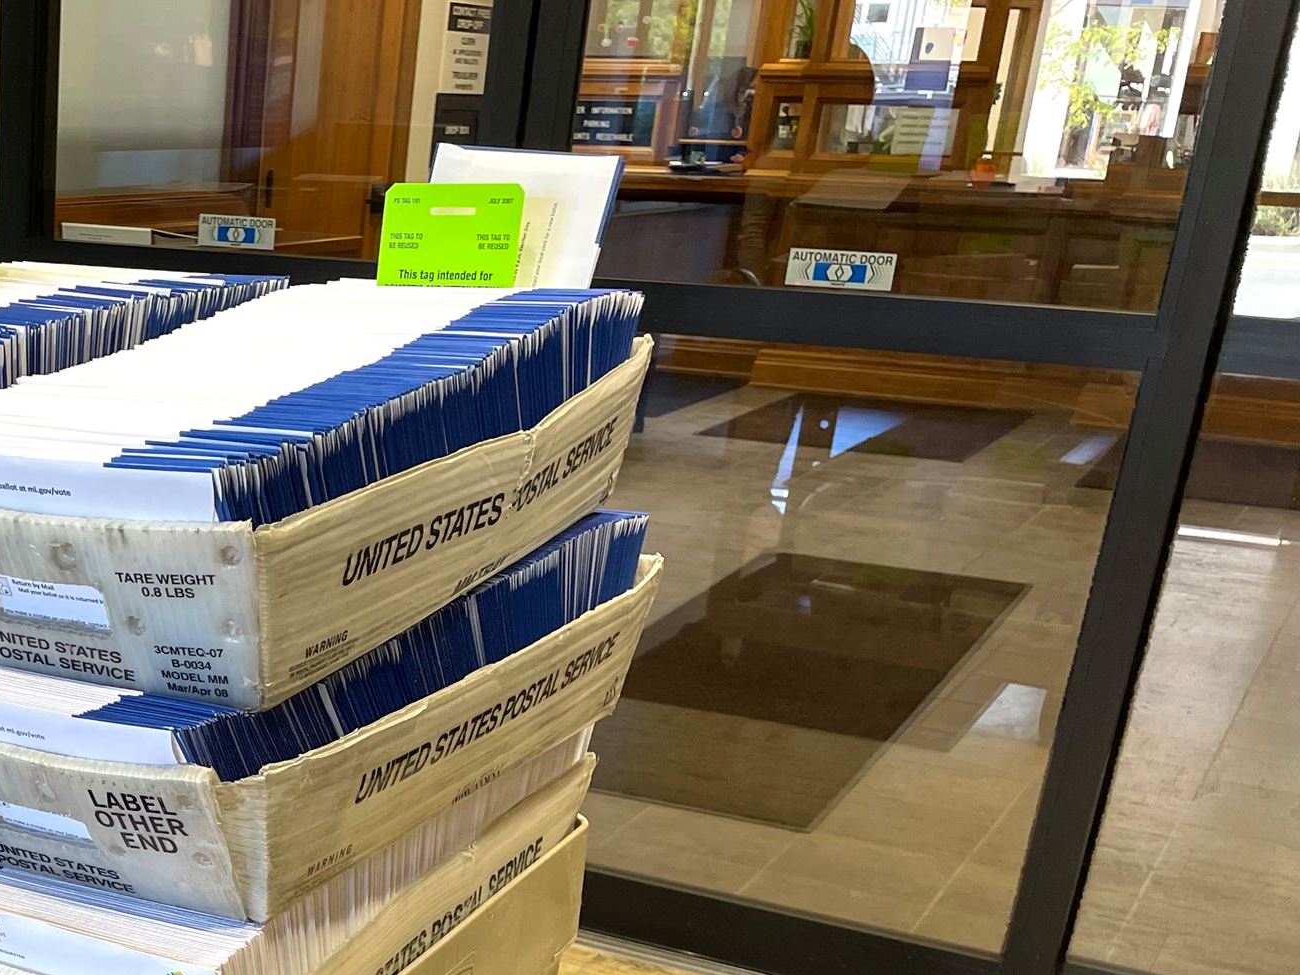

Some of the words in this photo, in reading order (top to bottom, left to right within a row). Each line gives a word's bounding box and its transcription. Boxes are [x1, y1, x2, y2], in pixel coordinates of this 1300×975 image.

[202, 217, 248, 226] AUTOMATIC
[249, 219, 273, 228] DOOR
[793, 251, 857, 264] AUTOMATIC
[860, 255, 893, 266] DOOR
[399, 269, 417, 279] This
[420, 271, 434, 281] tag
[437, 270, 476, 280] intended
[480, 271, 492, 281] for
[26, 485, 72, 497] mi.gov/vote
[343, 525, 424, 586] UNITED
[426, 493, 505, 550] STATES
[562, 416, 618, 479] SERVICE
[12, 579, 31, 587] Return
[115, 572, 154, 584] TARE
[156, 574, 216, 585] WEIGHT
[142, 587, 162, 597] 0.8
[165, 588, 195, 598] LBS
[54, 640, 122, 663] STATES
[305, 631, 349, 659] WARNING
[60, 658, 135, 681] SERVICE
[171, 660, 211, 670] B-0034
[162, 671, 205, 682] MODEL
[208, 675, 229, 684] MM
[167, 682, 211, 696] Mar/Apr
[215, 688, 228, 697] 08
[354, 742, 432, 805] UNITED
[430, 703, 502, 765] STATES
[500, 669, 560, 727] POSTAL
[560, 631, 620, 689] SERVICE
[88, 790, 177, 816] LABEL
[95, 811, 189, 836] OTHER
[121, 832, 178, 854] END
[54, 857, 119, 880] STATES
[307, 844, 352, 875] WARNING
[488, 836, 543, 898] SERVICE
[64, 871, 135, 893] SERVICE
